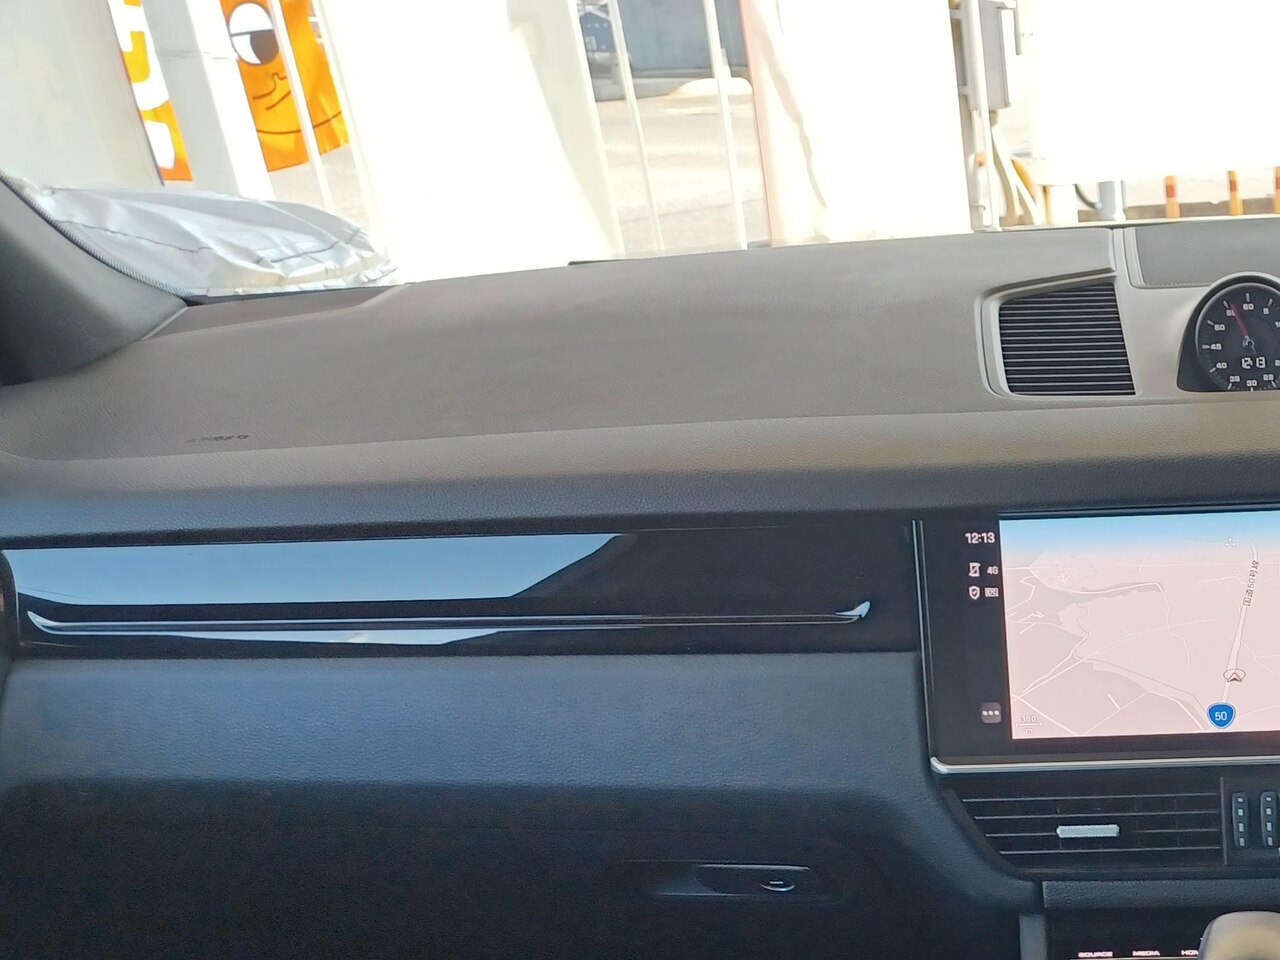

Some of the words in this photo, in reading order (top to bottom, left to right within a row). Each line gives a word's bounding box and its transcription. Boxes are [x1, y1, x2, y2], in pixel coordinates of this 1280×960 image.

[965, 532, 996, 544] 12:13
[987, 566, 999, 575] 4G
[1242, 560, 1260, 607] 国道50号線
[1215, 711, 1228, 721] 50
